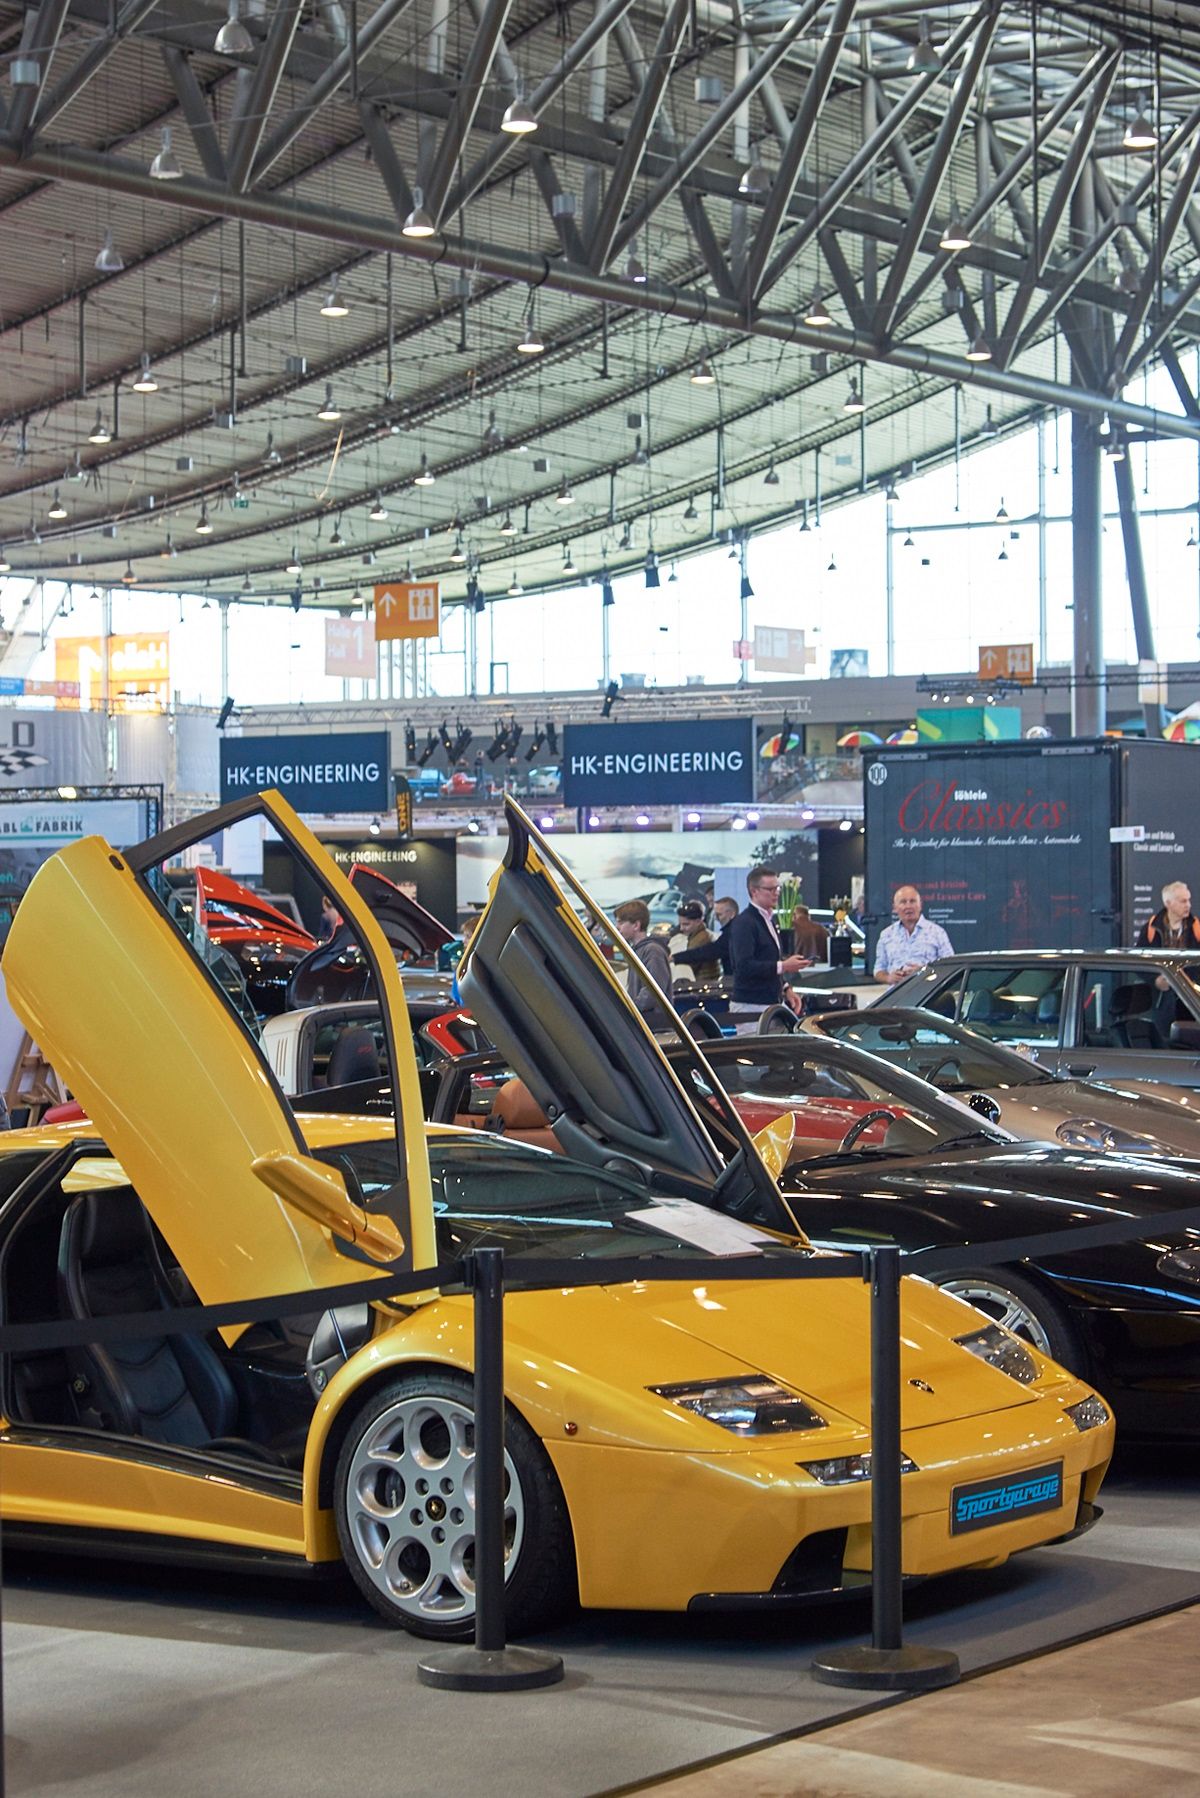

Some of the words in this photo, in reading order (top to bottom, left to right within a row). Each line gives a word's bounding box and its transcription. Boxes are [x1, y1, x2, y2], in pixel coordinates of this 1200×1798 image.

[226, 763, 380, 785] HK-ENGINEERING
[571, 751, 744, 775] HK-ENGINEERING
[897, 779, 1068, 833] Classics
[36, 820, 83, 832] FABRIK
[956, 1474, 1059, 1522] Sportgarage
